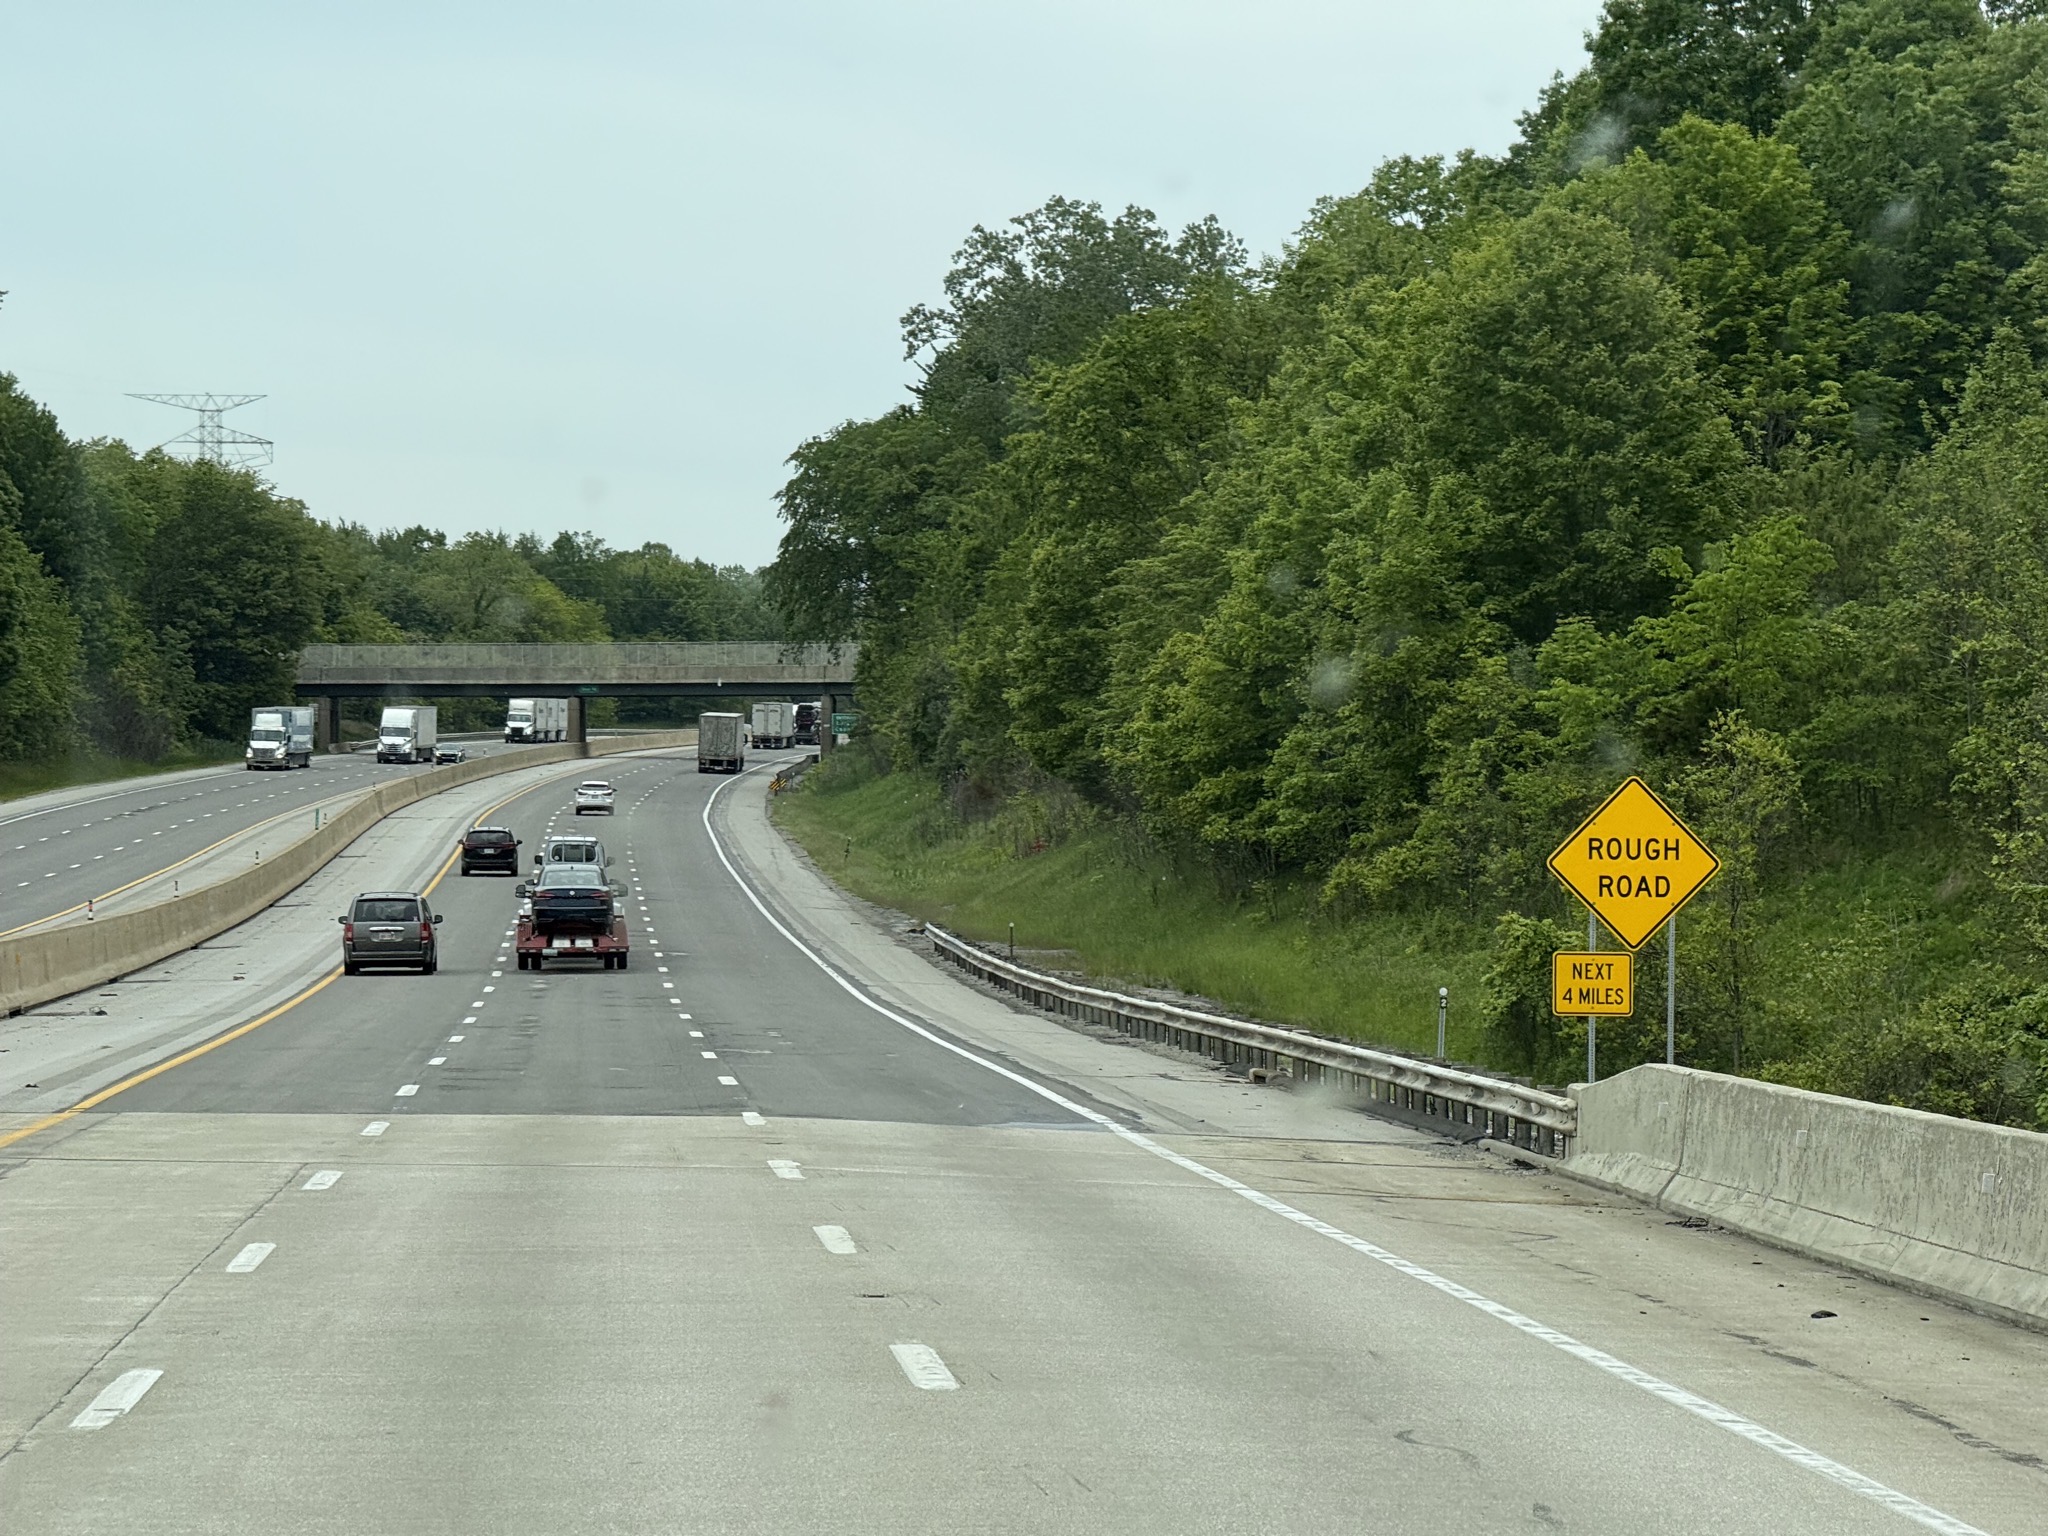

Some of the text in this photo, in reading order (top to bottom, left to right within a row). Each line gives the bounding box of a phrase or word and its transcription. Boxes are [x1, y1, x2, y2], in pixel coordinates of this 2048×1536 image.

[1588, 837, 1680, 861] ROUGH
[1598, 875, 1671, 898] ROAD
[1572, 962, 1614, 980] NEXT
[1440, 998, 1447, 1007] 2
[1562, 987, 1624, 1005] 4 MILES
